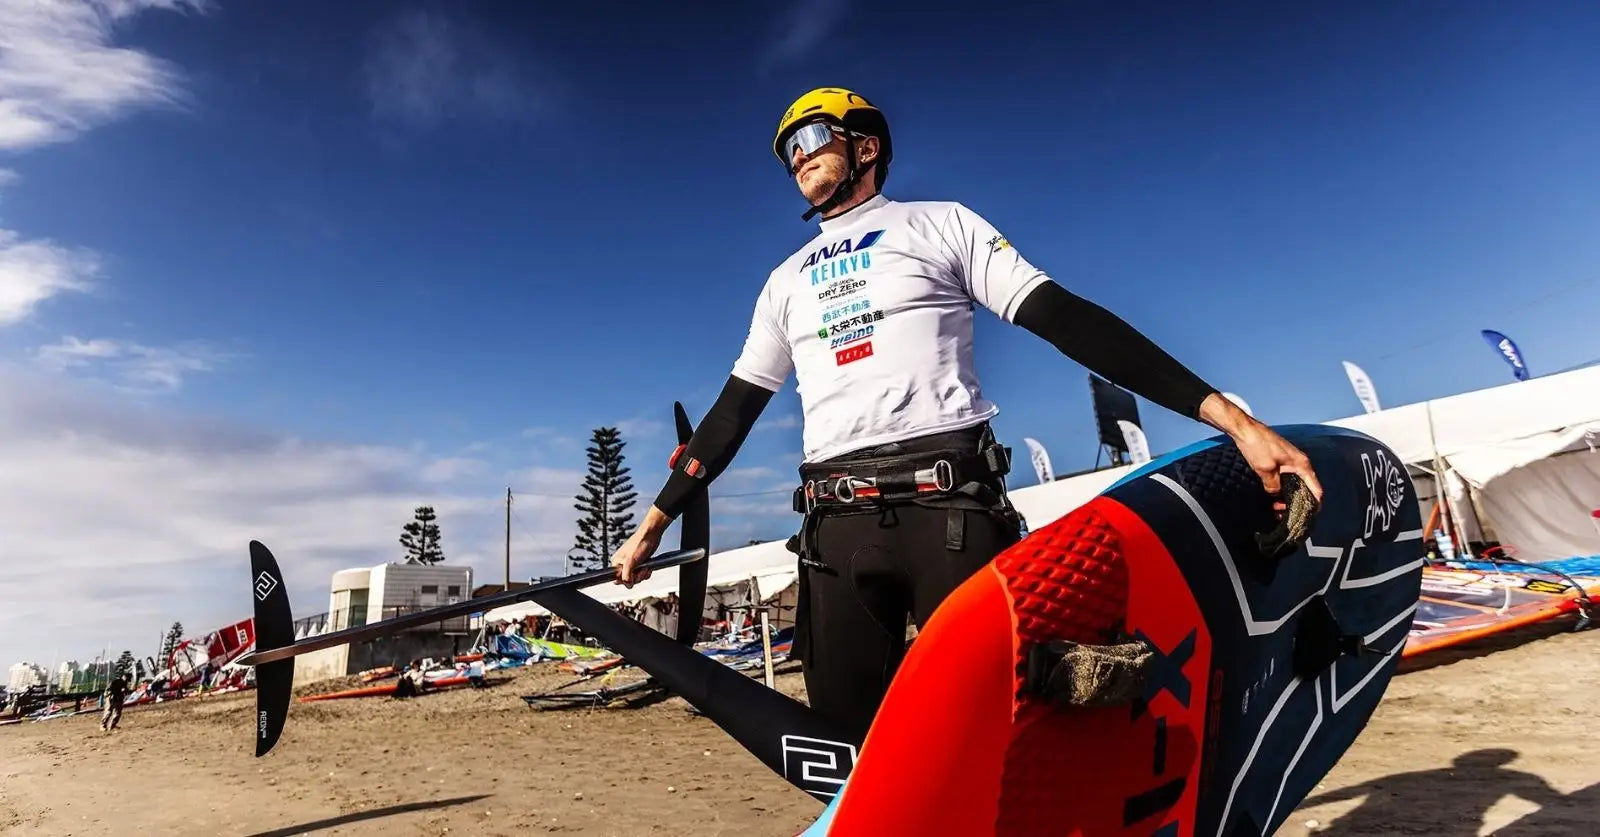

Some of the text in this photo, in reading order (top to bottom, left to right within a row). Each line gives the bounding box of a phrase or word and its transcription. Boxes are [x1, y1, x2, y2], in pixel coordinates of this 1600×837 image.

[800, 238, 851, 273] ANA
[811, 252, 871, 285] KEIKYU
[818, 287, 837, 299] DRY
[840, 280, 866, 292] ZERO
[822, 300, 871, 323] 西武不動産
[829, 310, 885, 335] 大栄不動産
[831, 325, 874, 347] HIBINO
